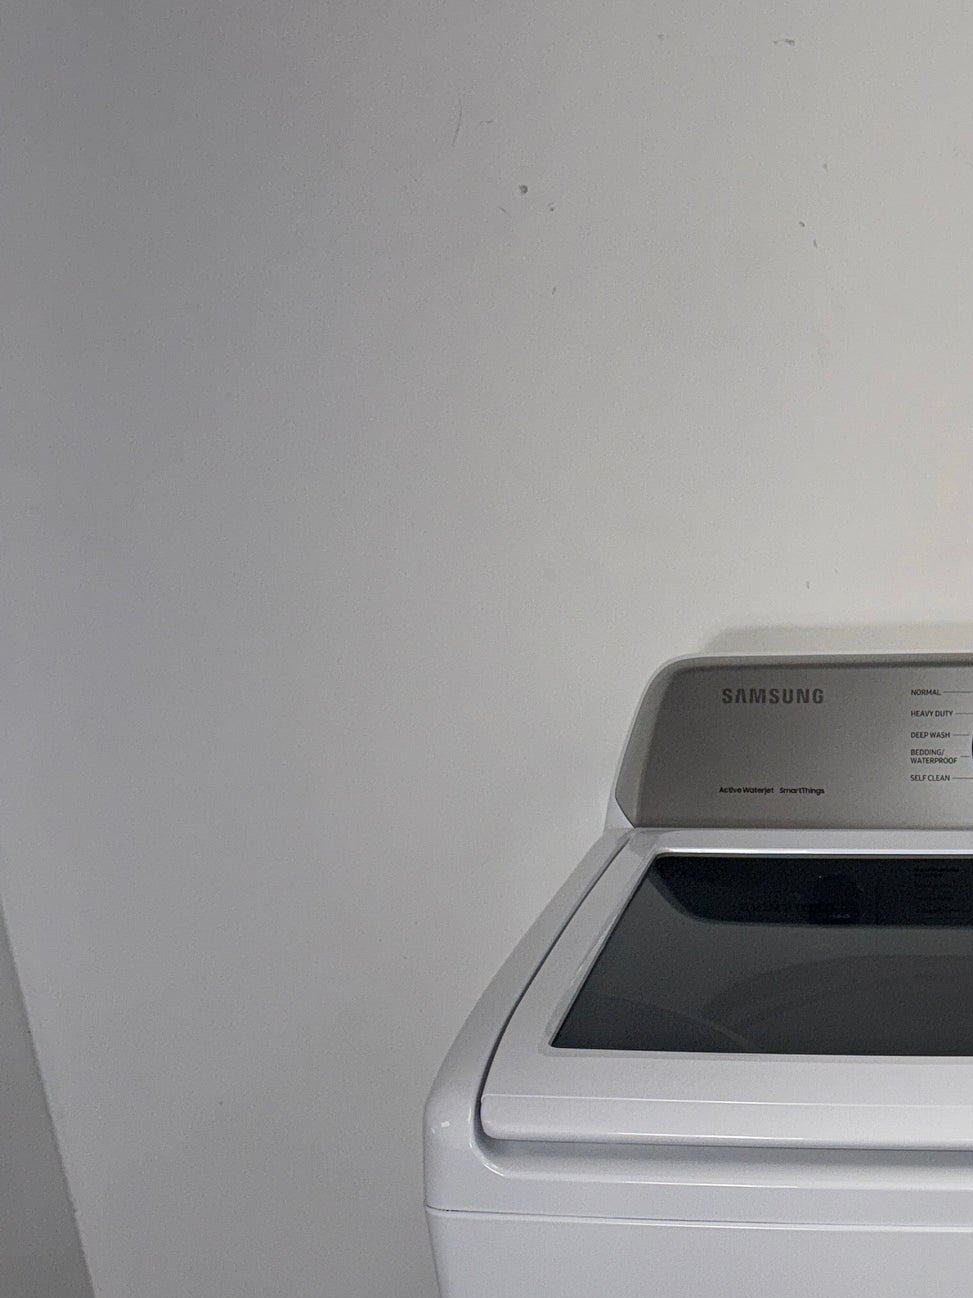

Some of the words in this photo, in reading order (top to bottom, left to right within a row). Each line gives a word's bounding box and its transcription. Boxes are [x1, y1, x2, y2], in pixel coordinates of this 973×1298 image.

[722, 688, 825, 704] SAMSUNG
[719, 786, 742, 795] Active
[779, 787, 825, 796] SmartThings
